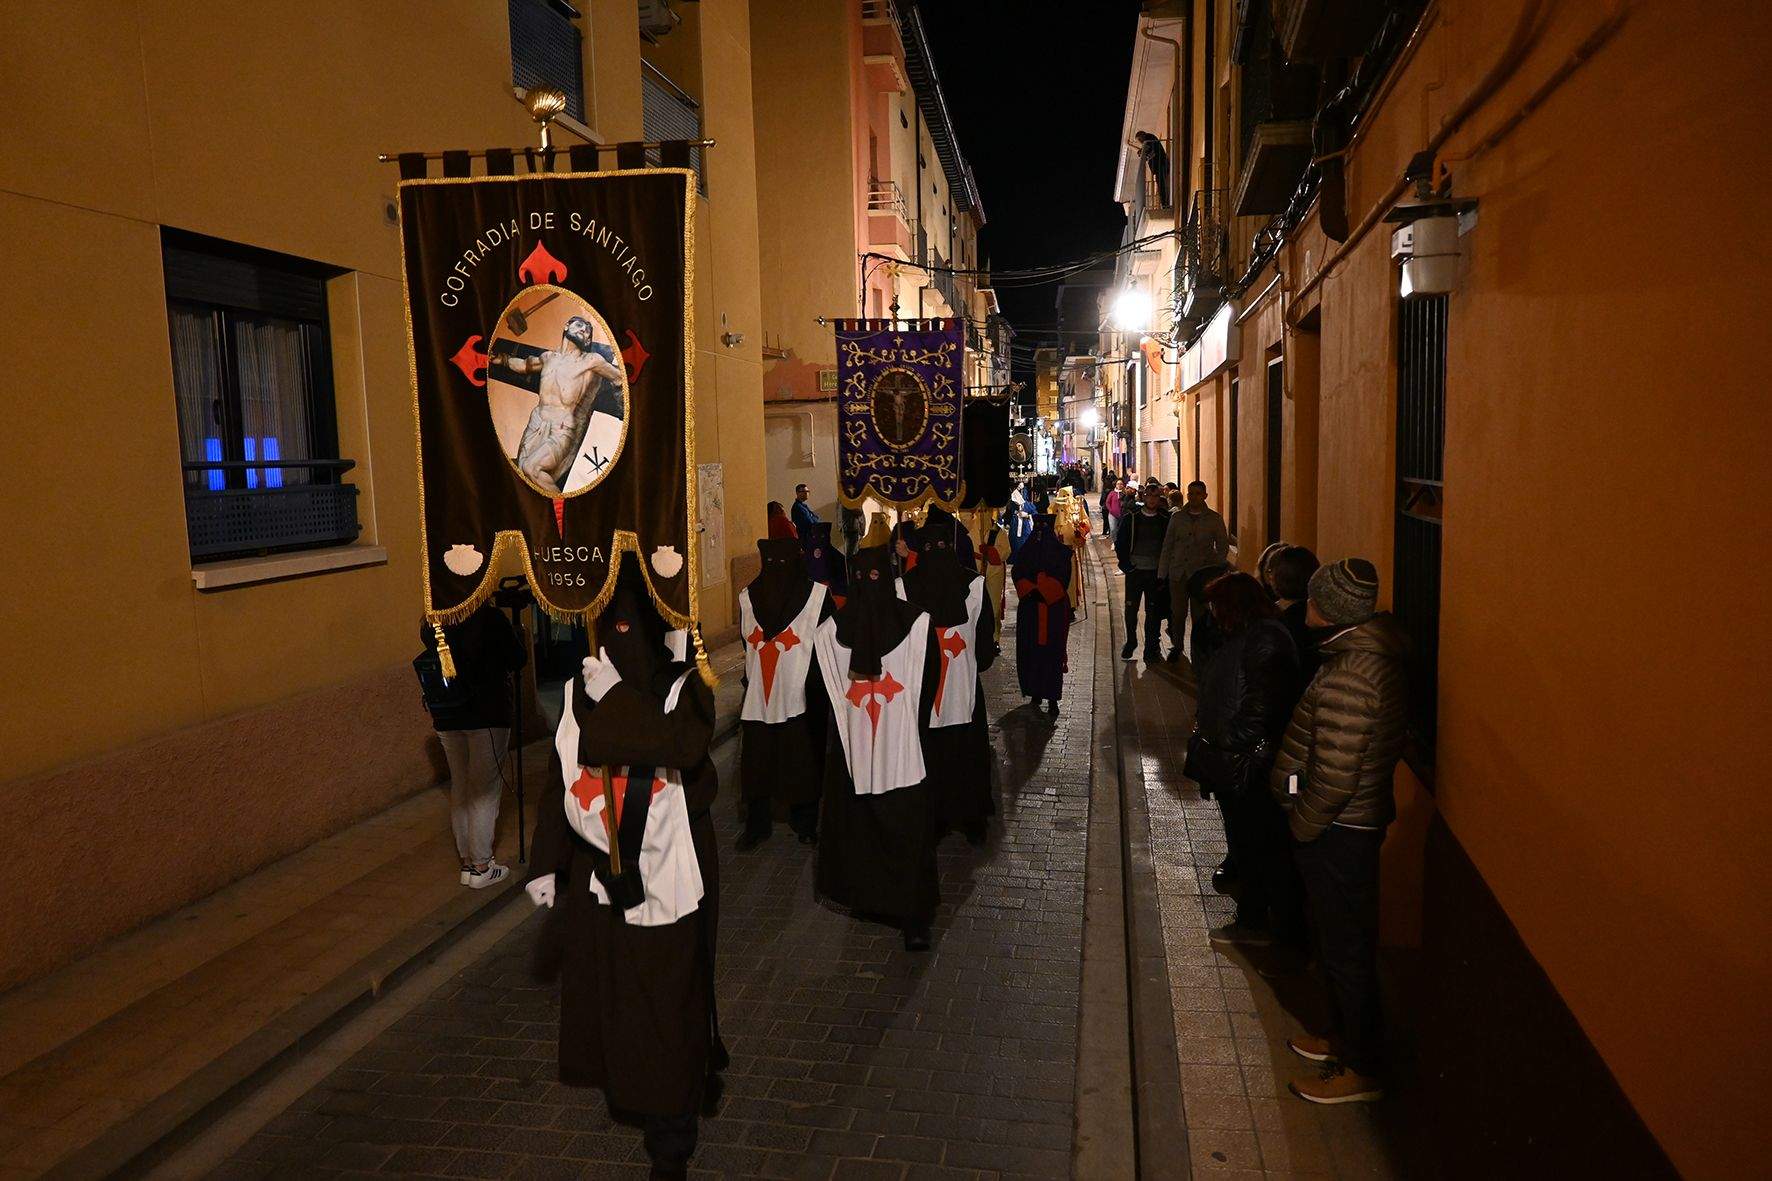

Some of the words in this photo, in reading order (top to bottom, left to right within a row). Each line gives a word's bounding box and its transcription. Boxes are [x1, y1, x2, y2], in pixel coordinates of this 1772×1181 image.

[440, 218, 521, 307] COFRADIA
[530, 212, 555, 230] DE
[570, 212, 654, 302] SANTIAGO
[548, 571, 586, 587] 1956
